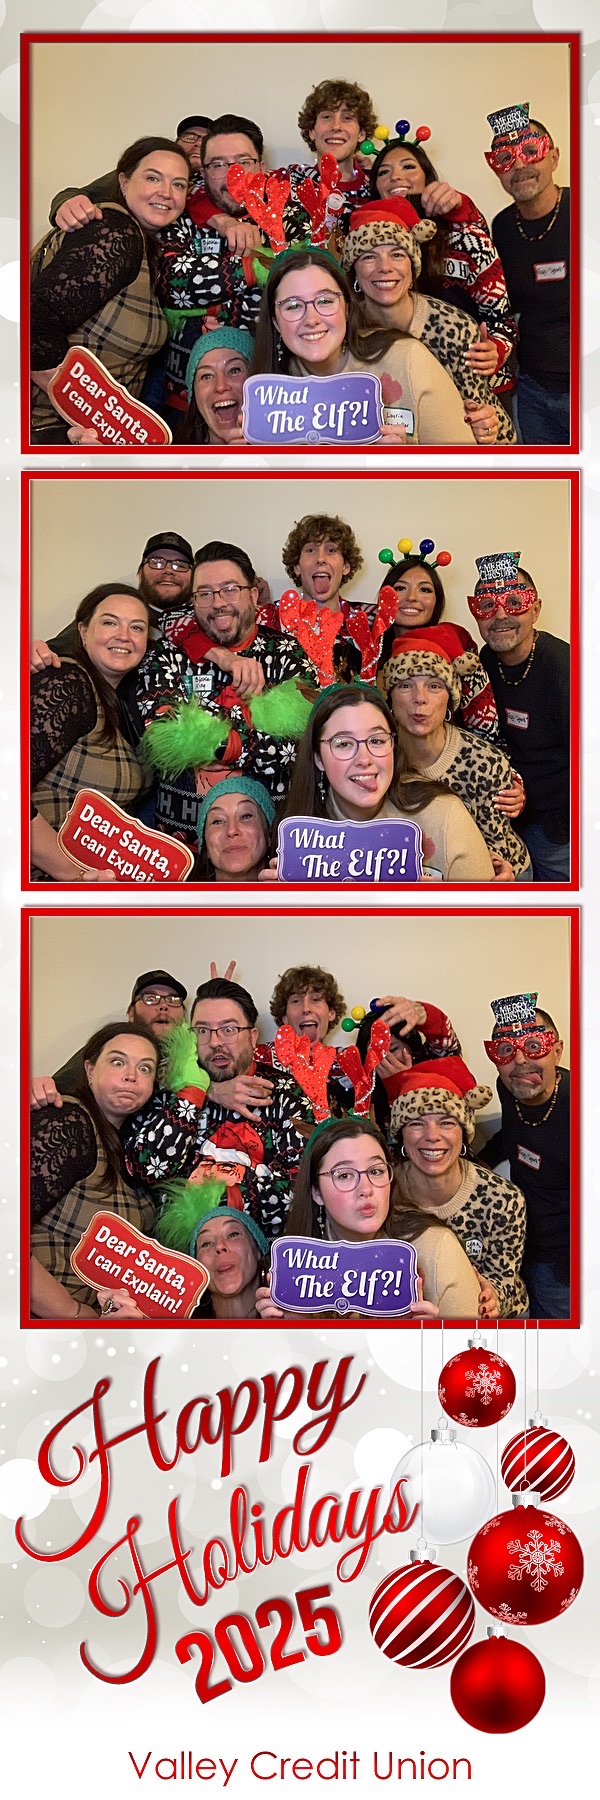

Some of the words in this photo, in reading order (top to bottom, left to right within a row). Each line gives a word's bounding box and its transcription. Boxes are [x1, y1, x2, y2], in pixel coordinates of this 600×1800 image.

[69, 361, 106, 399] Dear
[167, 350, 183, 378] H,
[62, 381, 71, 393] I
[68, 391, 92, 416] can
[254, 385, 309, 406] What
[267, 410, 305, 434] The
[312, 400, 369, 436] Elf?!
[156, 789, 174, 819] H,
[73, 826, 82, 840] I
[80, 834, 107, 858] can
[79, 804, 120, 838] Dear
[119, 830, 171, 878] Santa,
[289, 828, 346, 850] What
[302, 854, 341, 878] The
[348, 848, 408, 882] Elf?!
[95, 1225, 137, 1258] Dear
[134, 1250, 186, 1296] Santa,
[282, 1248, 339, 1270] What
[86, 1247, 97, 1261] I
[94, 1254, 122, 1277] can
[121, 1268, 183, 1314] Explain!
[295, 1274, 334, 1299] The
[341, 1269, 403, 1306] Elf?!
